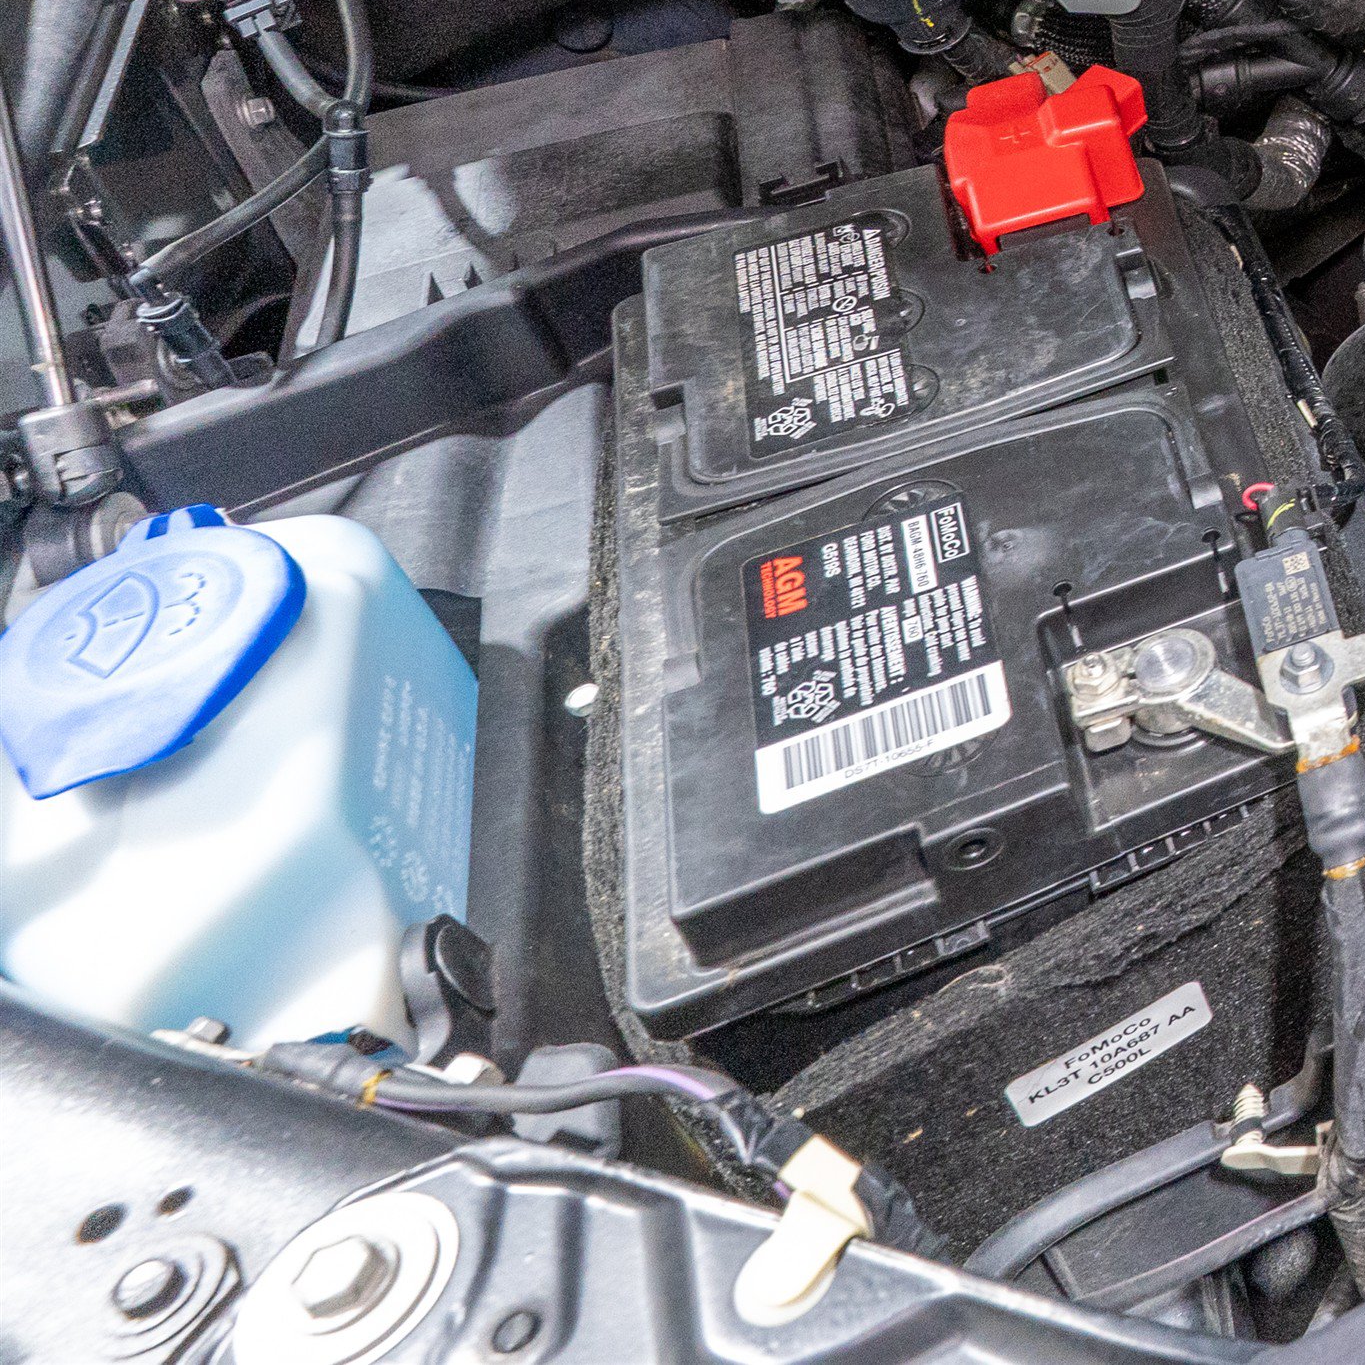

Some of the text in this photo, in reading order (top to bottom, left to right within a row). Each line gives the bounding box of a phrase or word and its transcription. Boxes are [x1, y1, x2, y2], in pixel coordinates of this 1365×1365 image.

[863, 236, 890, 300] DANGER/POISON
[936, 507, 961, 559] FoMoCo
[760, 561, 776, 620] TECHNOLOGY
[773, 551, 807, 617] AGM
[880, 604, 904, 678] AVERTISSEMENT
[906, 619, 918, 638] 760
[1028, 1005, 1196, 1104] KL3T 10A687 AA
[1064, 1017, 1151, 1069] FoMoCo
[1088, 1048, 1152, 1085] C500L
